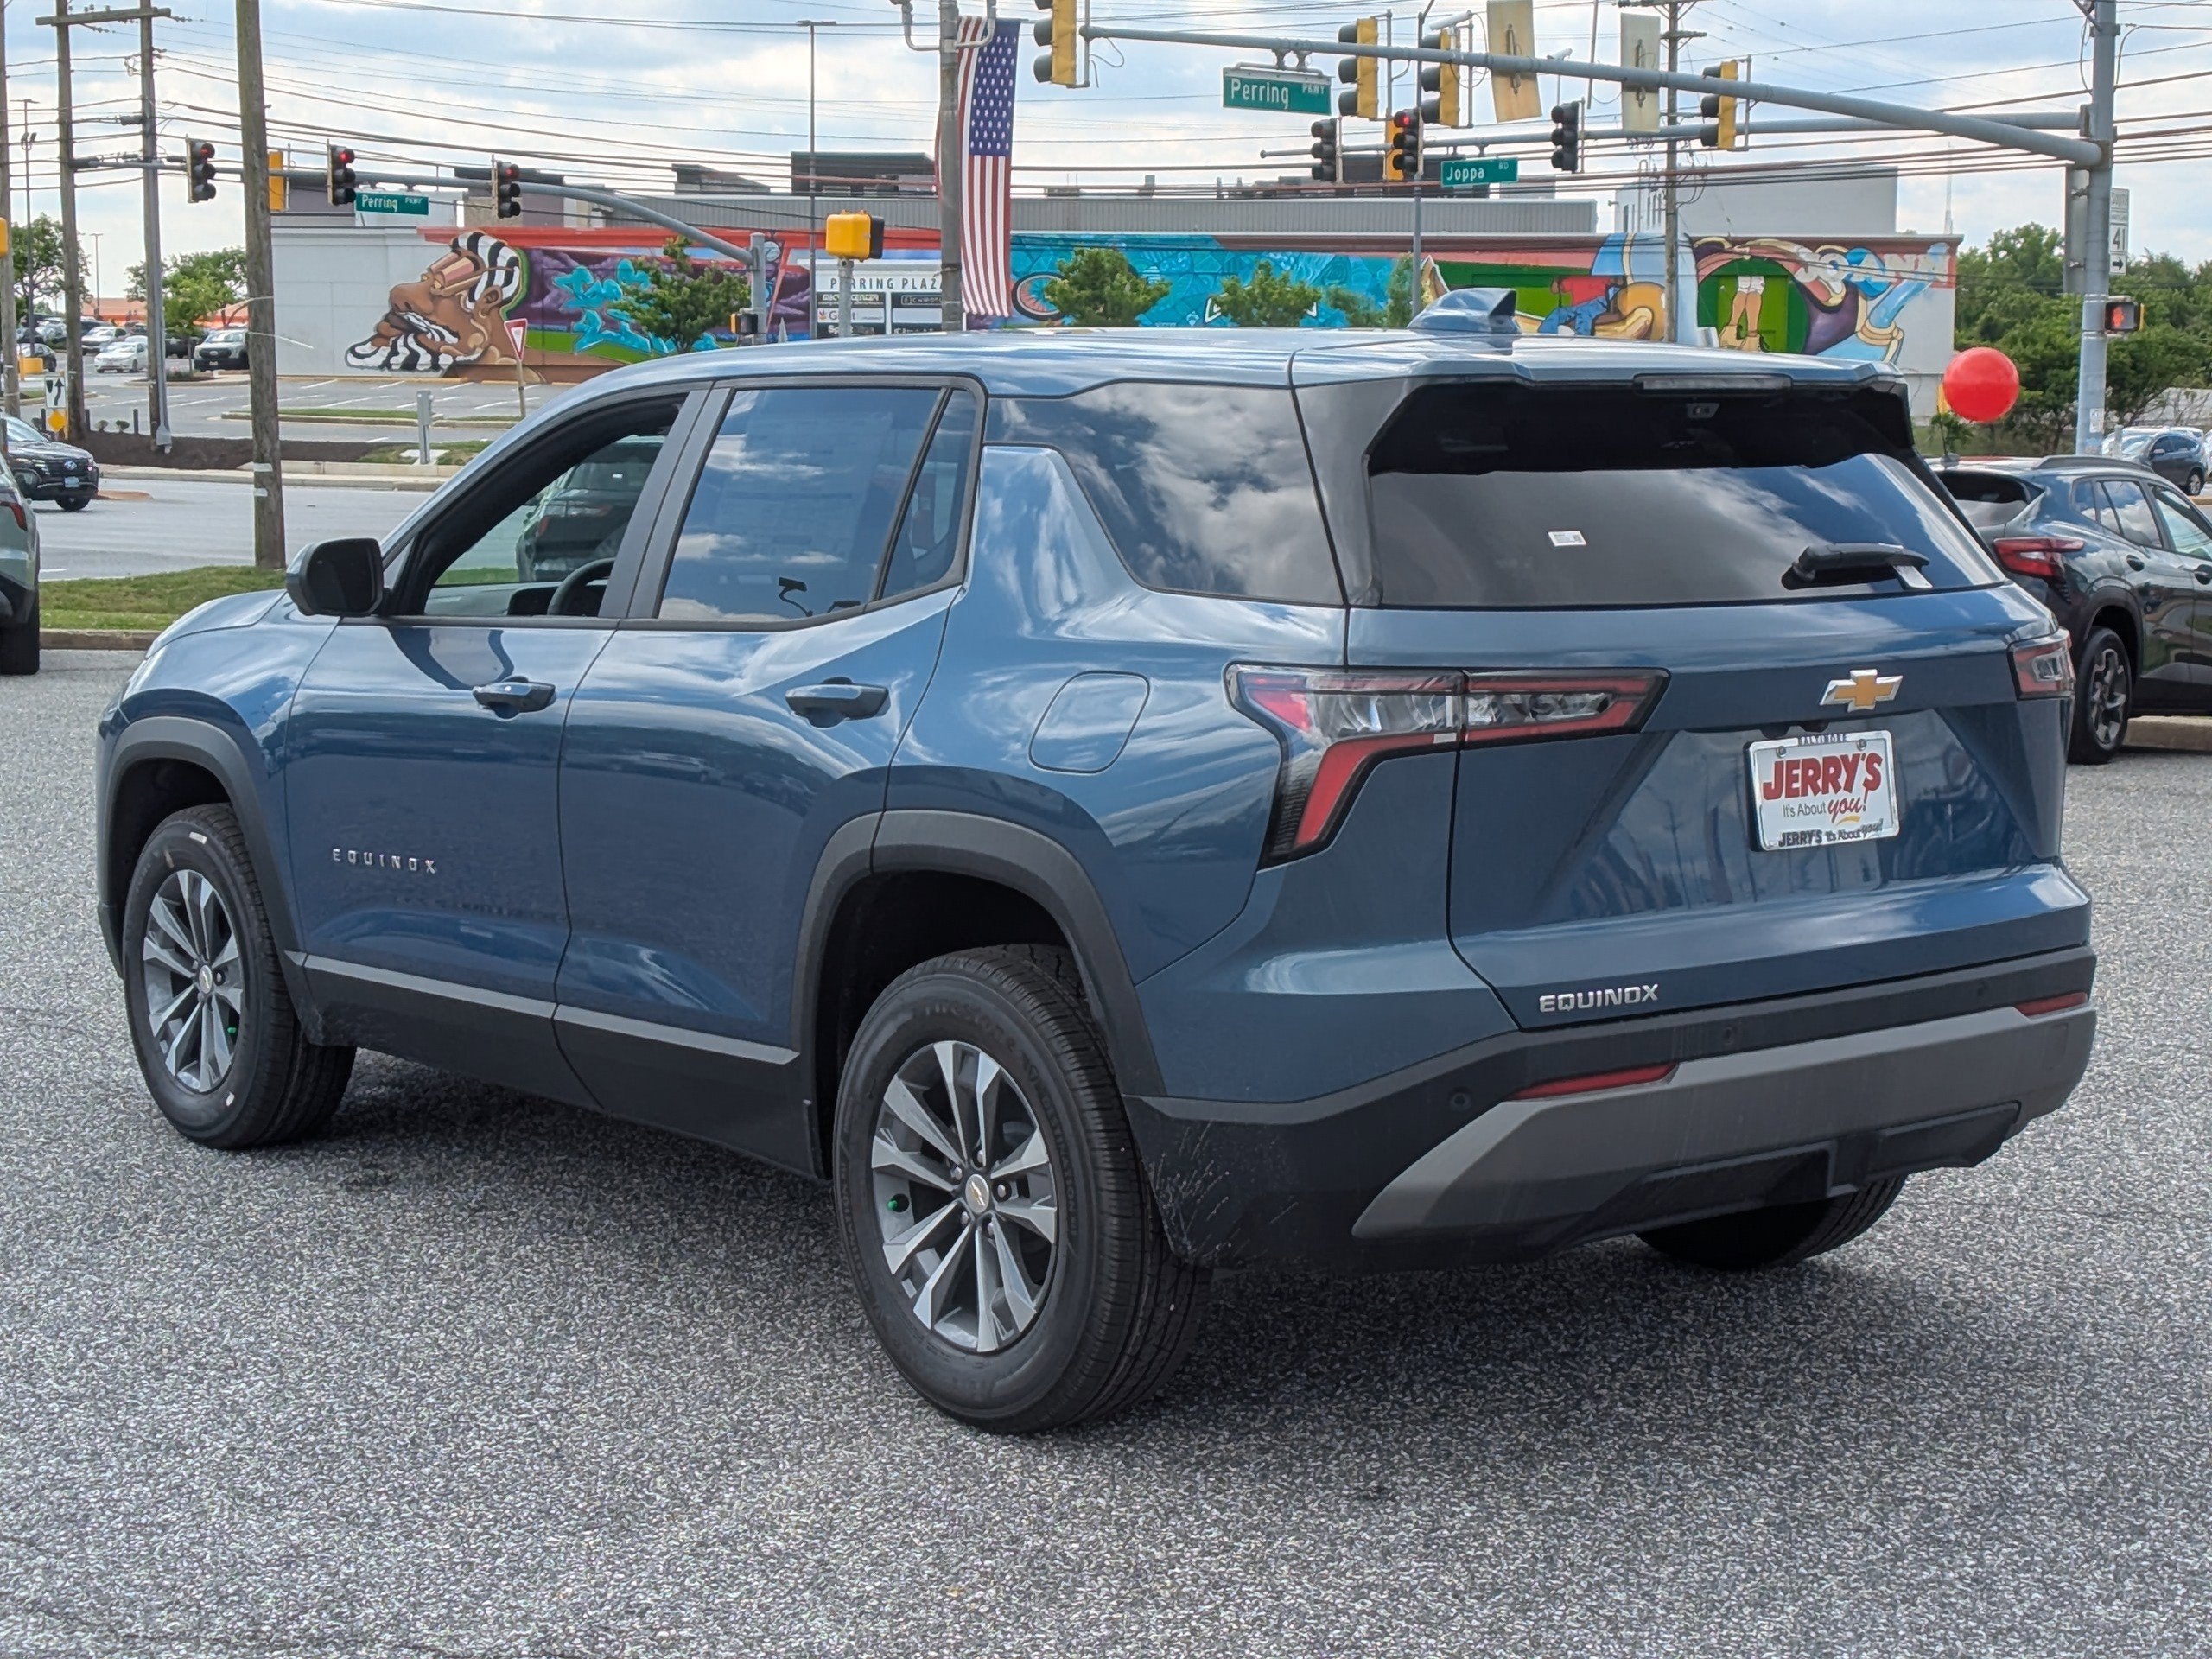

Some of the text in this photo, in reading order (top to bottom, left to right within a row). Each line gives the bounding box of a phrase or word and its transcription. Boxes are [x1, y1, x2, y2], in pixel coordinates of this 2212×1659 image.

[1230, 77, 1325, 110] Perring PKWY
[1446, 162, 1510, 182] Joppa RD
[361, 194, 397, 213] Perring
[2113, 227, 2126, 251] 41
[830, 277, 942, 289] PRRING PLAZ
[1763, 752, 1884, 801] JERRY'S
[1783, 789, 1867, 824] It's About you!
[332, 848, 436, 874] EQUINOX
[1539, 983, 1659, 1013] EQUINOX
